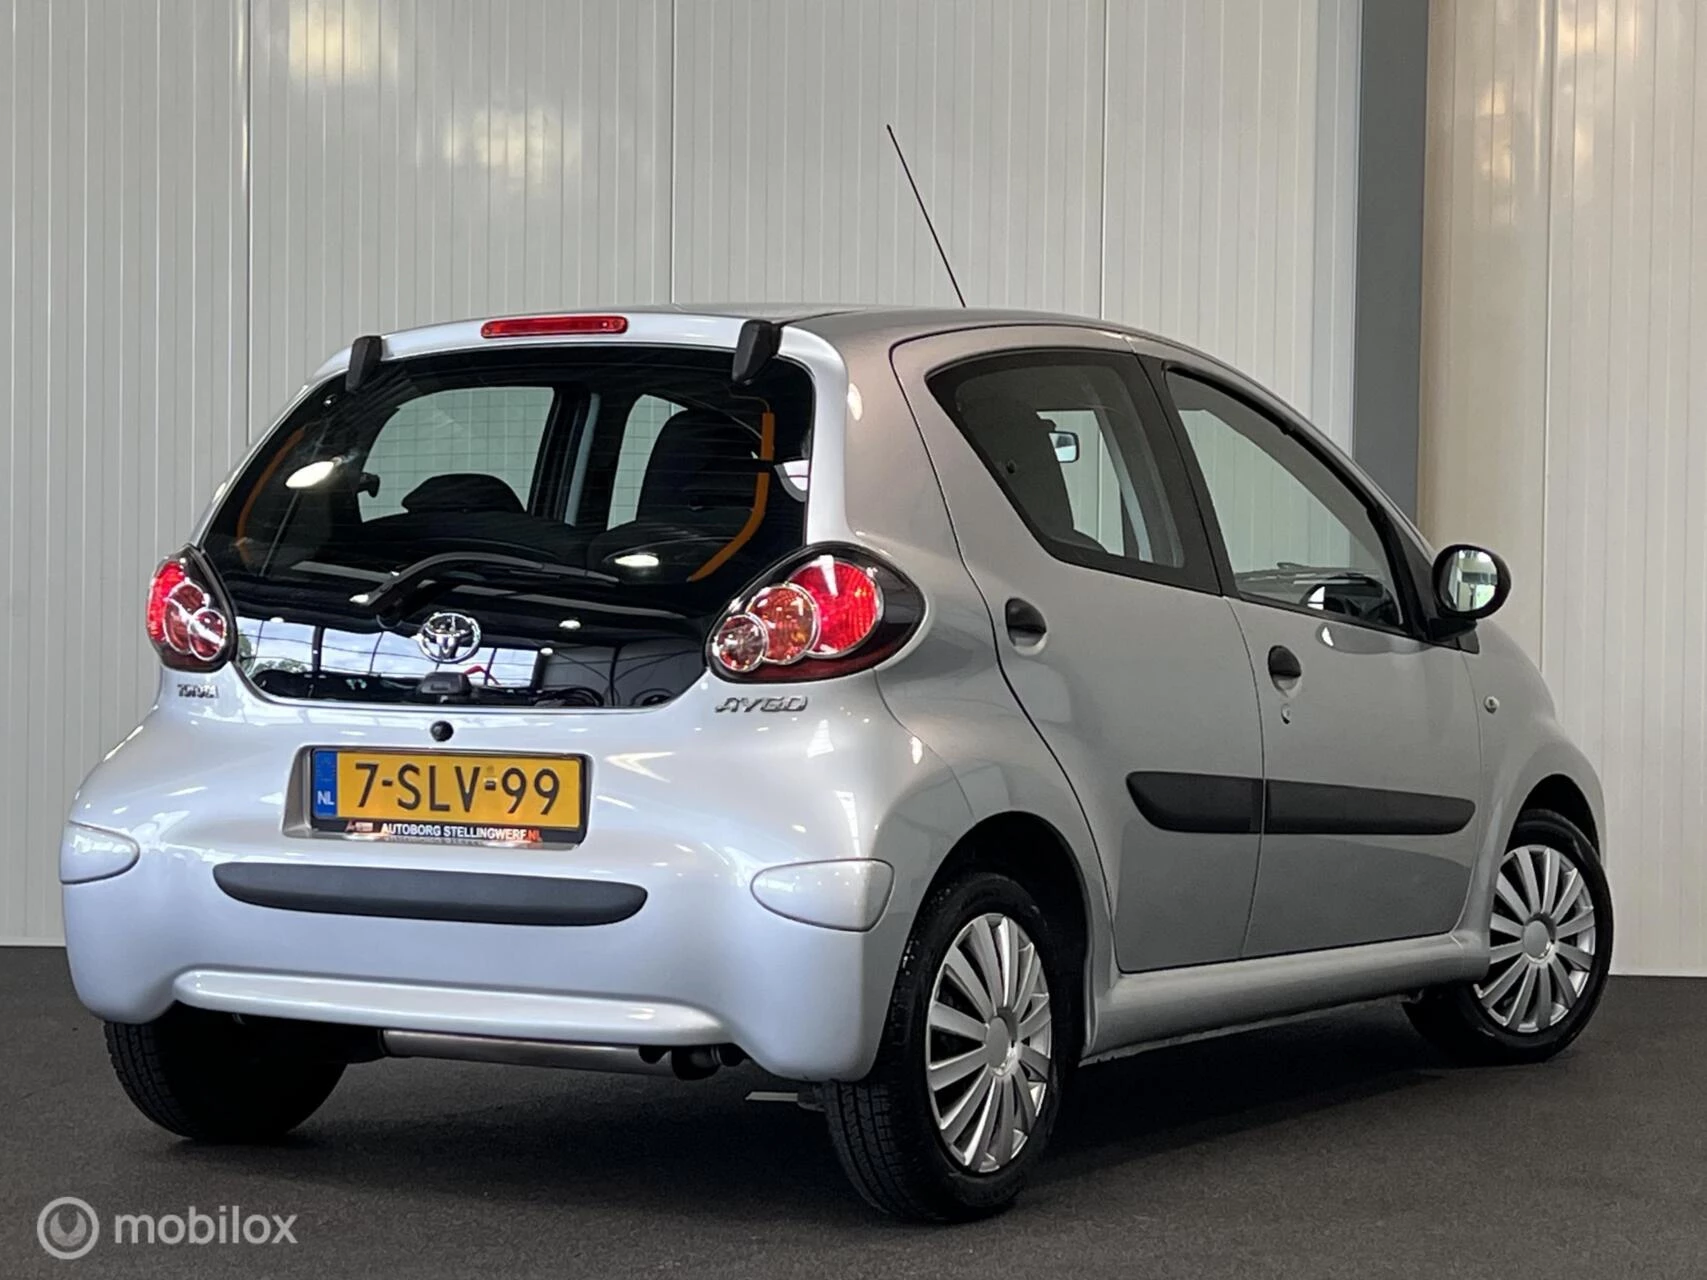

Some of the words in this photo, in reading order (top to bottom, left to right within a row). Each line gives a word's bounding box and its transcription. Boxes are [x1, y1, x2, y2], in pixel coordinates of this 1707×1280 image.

[715, 696, 808, 713] AYGO
[355, 763, 560, 815] 7-SLV-99
[317, 790, 335, 805] NL
[380, 823, 440, 837] AUTOBORG
